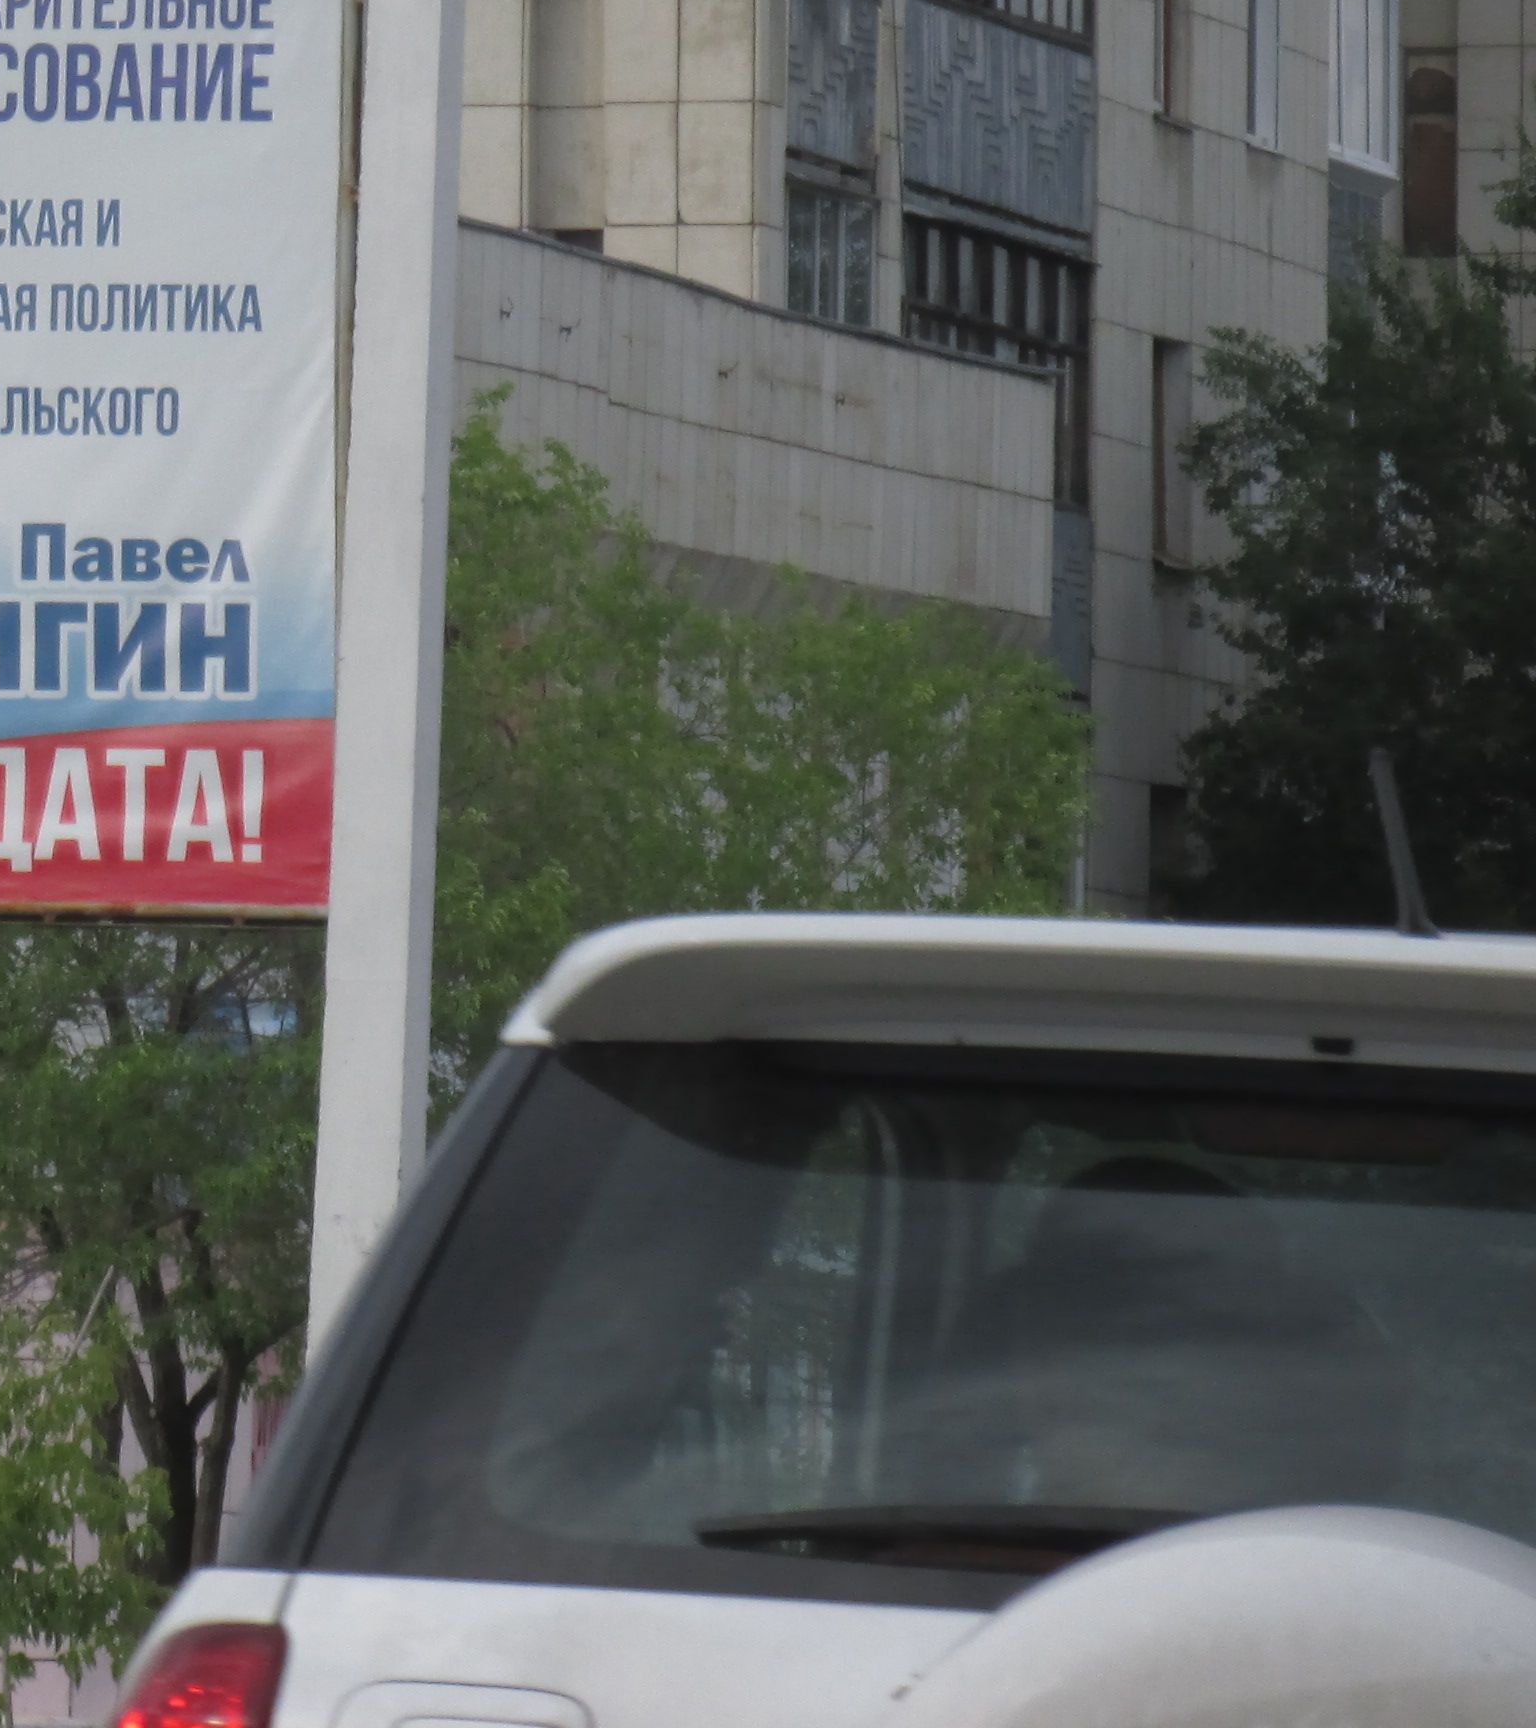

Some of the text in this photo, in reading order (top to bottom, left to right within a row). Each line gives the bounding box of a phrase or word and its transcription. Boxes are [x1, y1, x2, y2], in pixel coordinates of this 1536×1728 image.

[96, 198, 120, 247] И
[50, 283, 262, 333] ПОЛИТИКА
[20, 522, 250, 583] Павел
